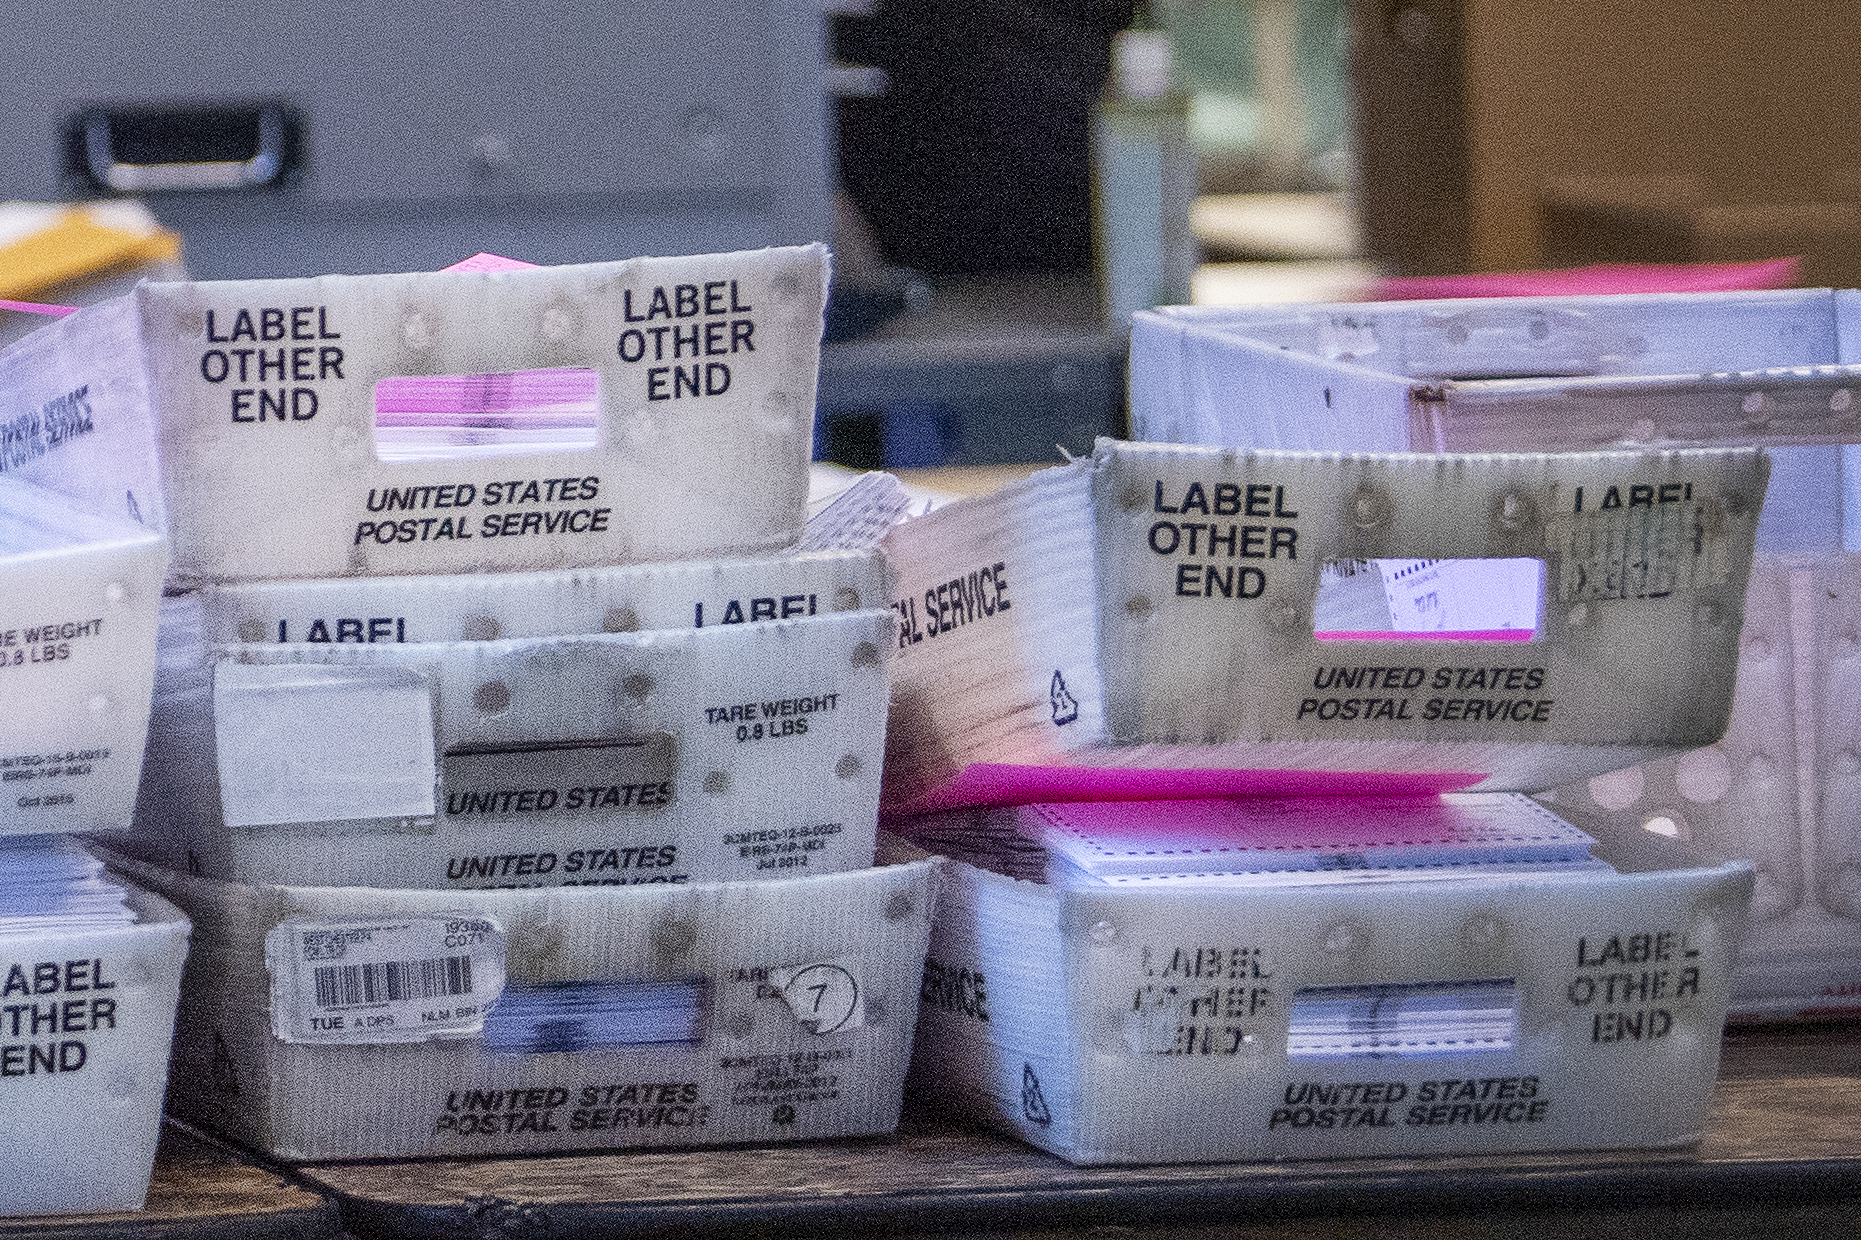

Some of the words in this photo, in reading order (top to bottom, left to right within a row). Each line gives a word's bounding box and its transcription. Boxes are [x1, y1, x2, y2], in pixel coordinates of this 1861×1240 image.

[624, 279, 752, 322] LABEL
[206, 306, 342, 343] LABEL
[617, 320, 756, 363] OTHER
[200, 346, 345, 384] OTHER
[648, 362, 731, 401] END
[231, 387, 319, 423] END
[366, 483, 476, 512] UNITED
[482, 476, 600, 506] STATES
[1154, 479, 1299, 519] LABEL
[353, 516, 473, 546] POSTAL
[480, 508, 612, 539] SERVICE
[1148, 521, 1299, 559] OTHER
[1176, 563, 1266, 599] END
[924, 561, 1011, 638] SERVICE
[24, 617, 103, 644] WEIGHT
[31, 642, 70, 664] LBS
[1313, 666, 1425, 691] UNITED
[1431, 667, 1545, 691] STATES
[706, 702, 757, 724] TARE
[762, 693, 840, 718] WEIGHT
[1297, 698, 1414, 721] POSTAL
[1422, 698, 1554, 722] SERVICE
[736, 723, 764, 743] 0.8
[769, 717, 808, 739] LBS
[446, 789, 558, 815] UNITED
[564, 781, 671, 810] STATES
[446, 853, 557, 880] UNITED
[563, 845, 677, 873] STATES
[807, 983, 828, 1014] 7
[311, 1017, 344, 1031] TUE
[1592, 1009, 1673, 1043] END
[1, 1040, 87, 1077] END
[445, 1087, 569, 1112] UNITED
[578, 1082, 698, 1107] STATES
[1284, 1081, 1407, 1106] UNITED
[1417, 1074, 1539, 1102] STATES
[432, 1111, 557, 1138] POSTAL
[1269, 1106, 1397, 1131] POSTAL
[1405, 1099, 1548, 1126] SERVICE
